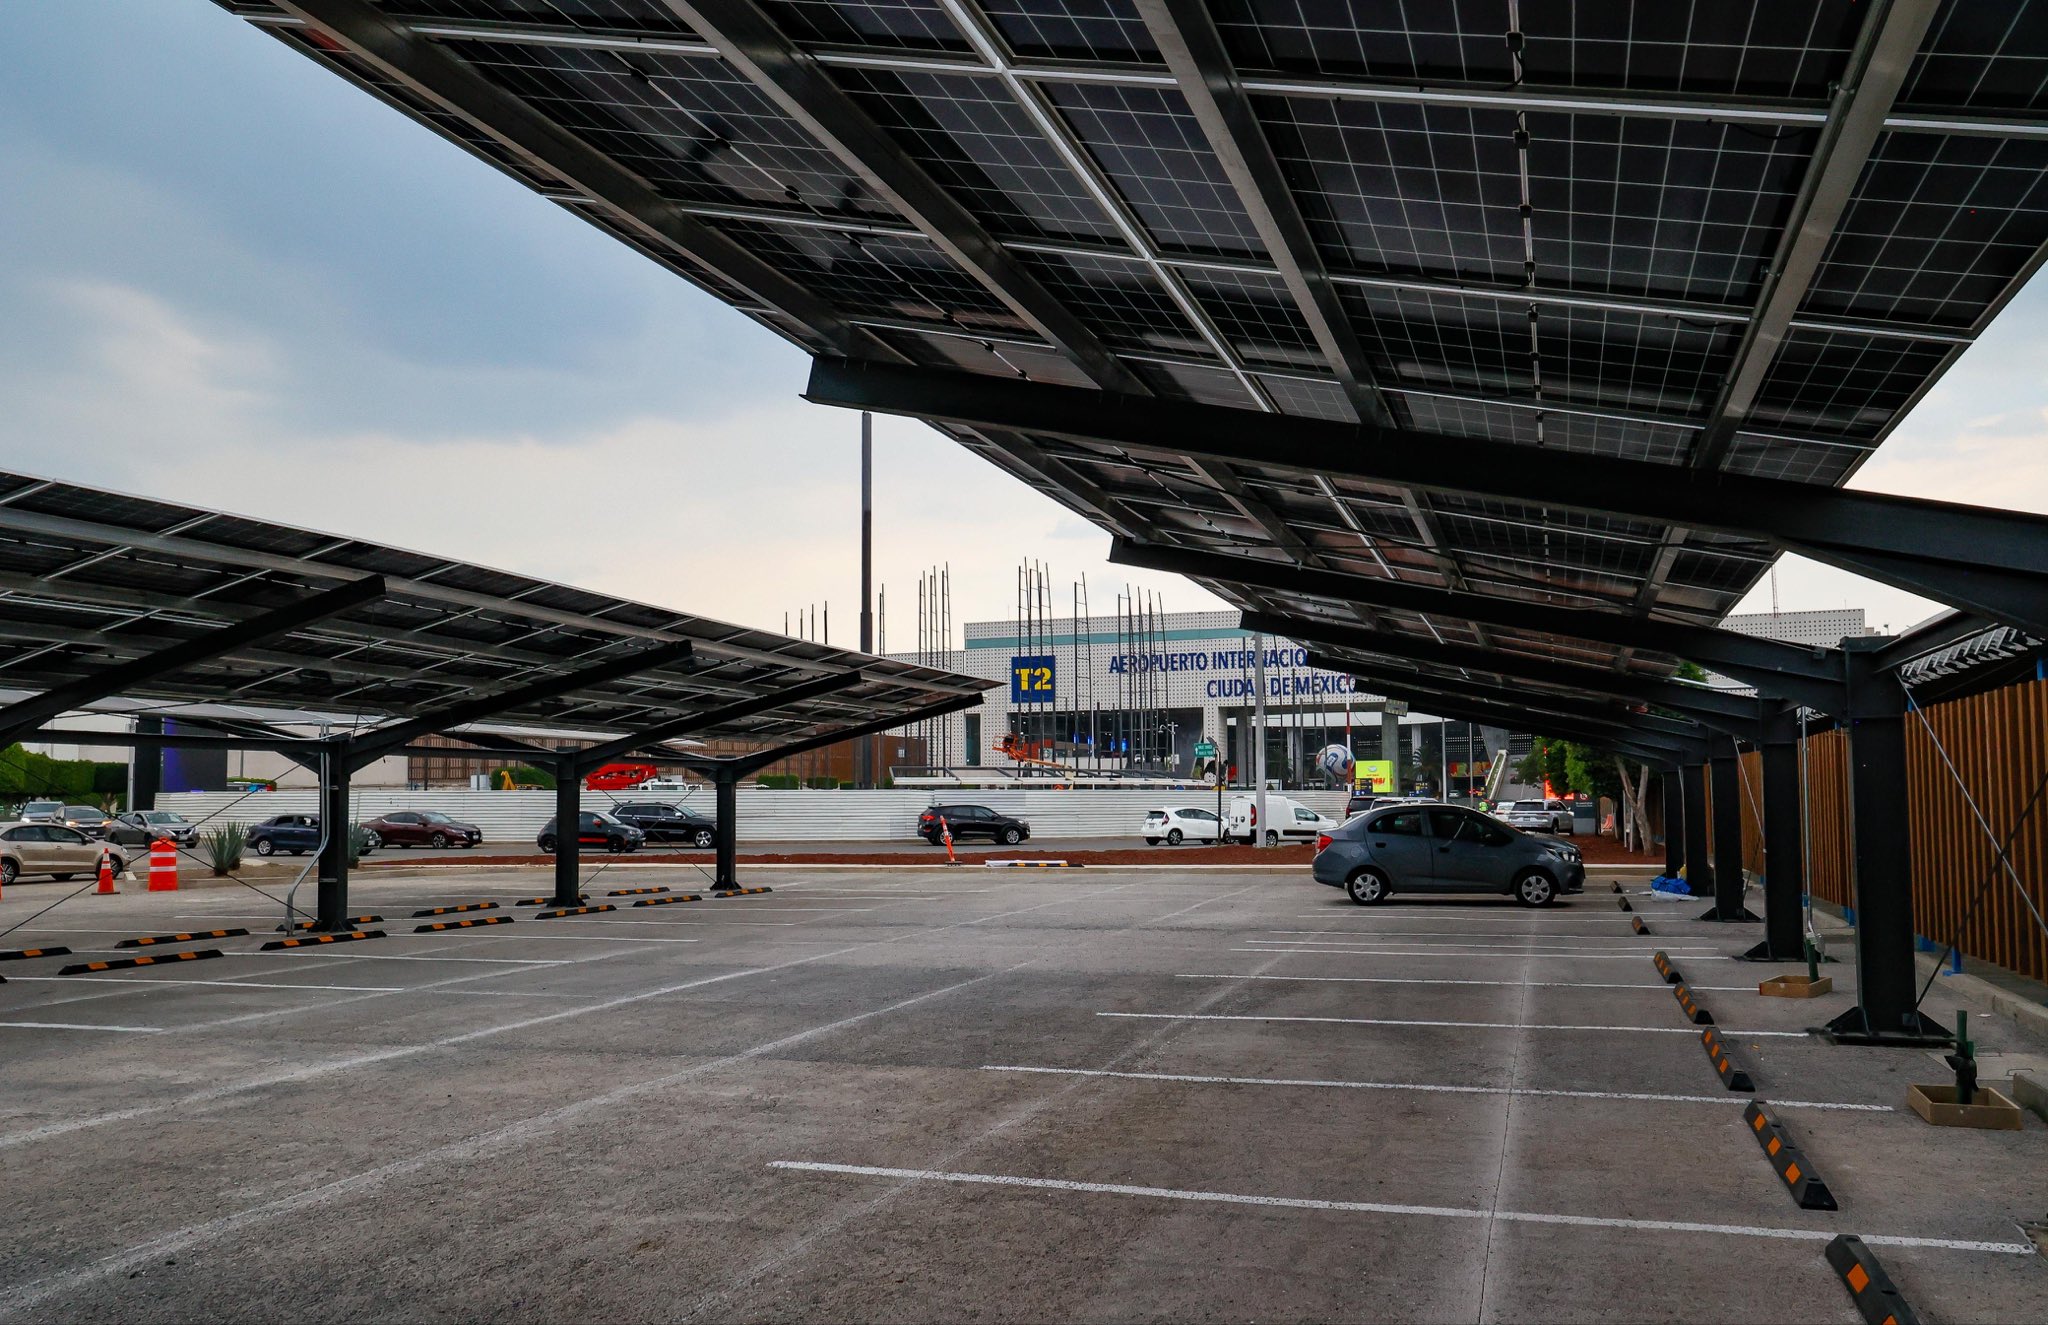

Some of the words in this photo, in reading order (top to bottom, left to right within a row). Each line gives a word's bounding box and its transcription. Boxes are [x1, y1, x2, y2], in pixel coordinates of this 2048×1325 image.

[1109, 652, 1208, 674] AEROPUERTO
[1212, 648, 1308, 669] INTERACIO
[1015, 667, 1052, 691] T2
[1207, 677, 1266, 698] CIUDA
[1270, 677, 1292, 697] DE
